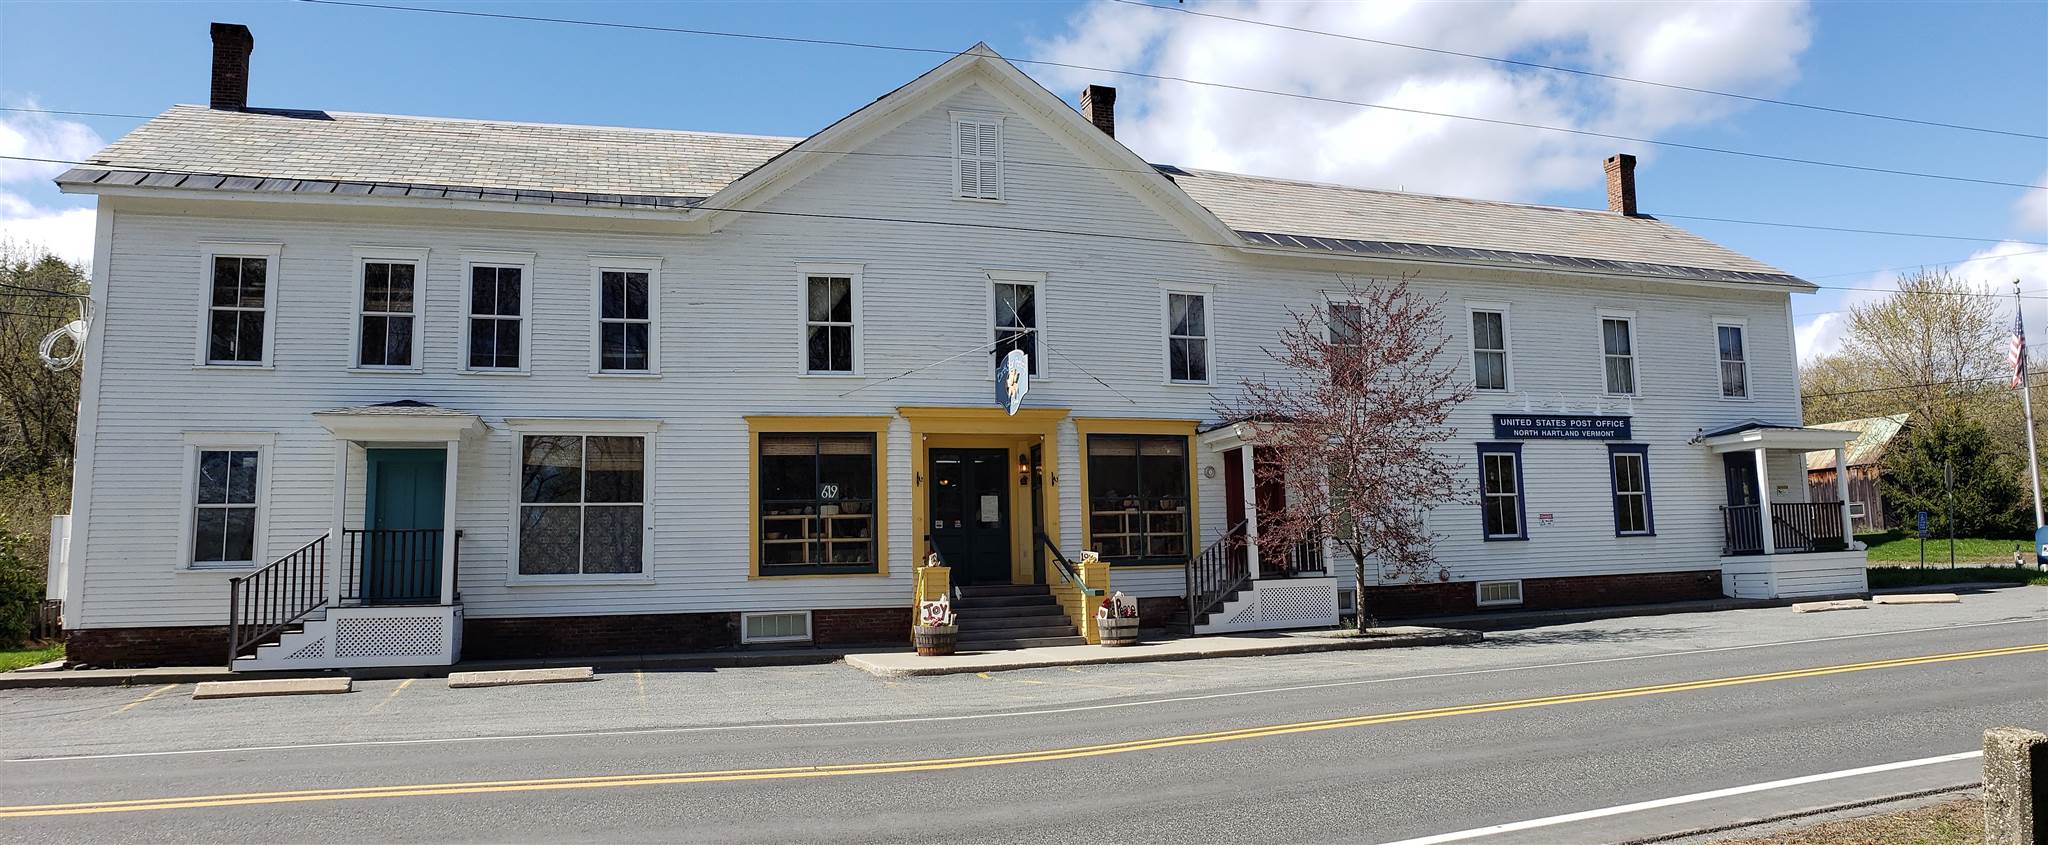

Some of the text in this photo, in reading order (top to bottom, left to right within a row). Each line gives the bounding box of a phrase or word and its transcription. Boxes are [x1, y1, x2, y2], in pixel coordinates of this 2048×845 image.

[1500, 418, 1625, 428] UNITED STATES POST OFFICE
[1541, 429, 1580, 437] HARTLAND
[821, 485, 838, 499] 619
